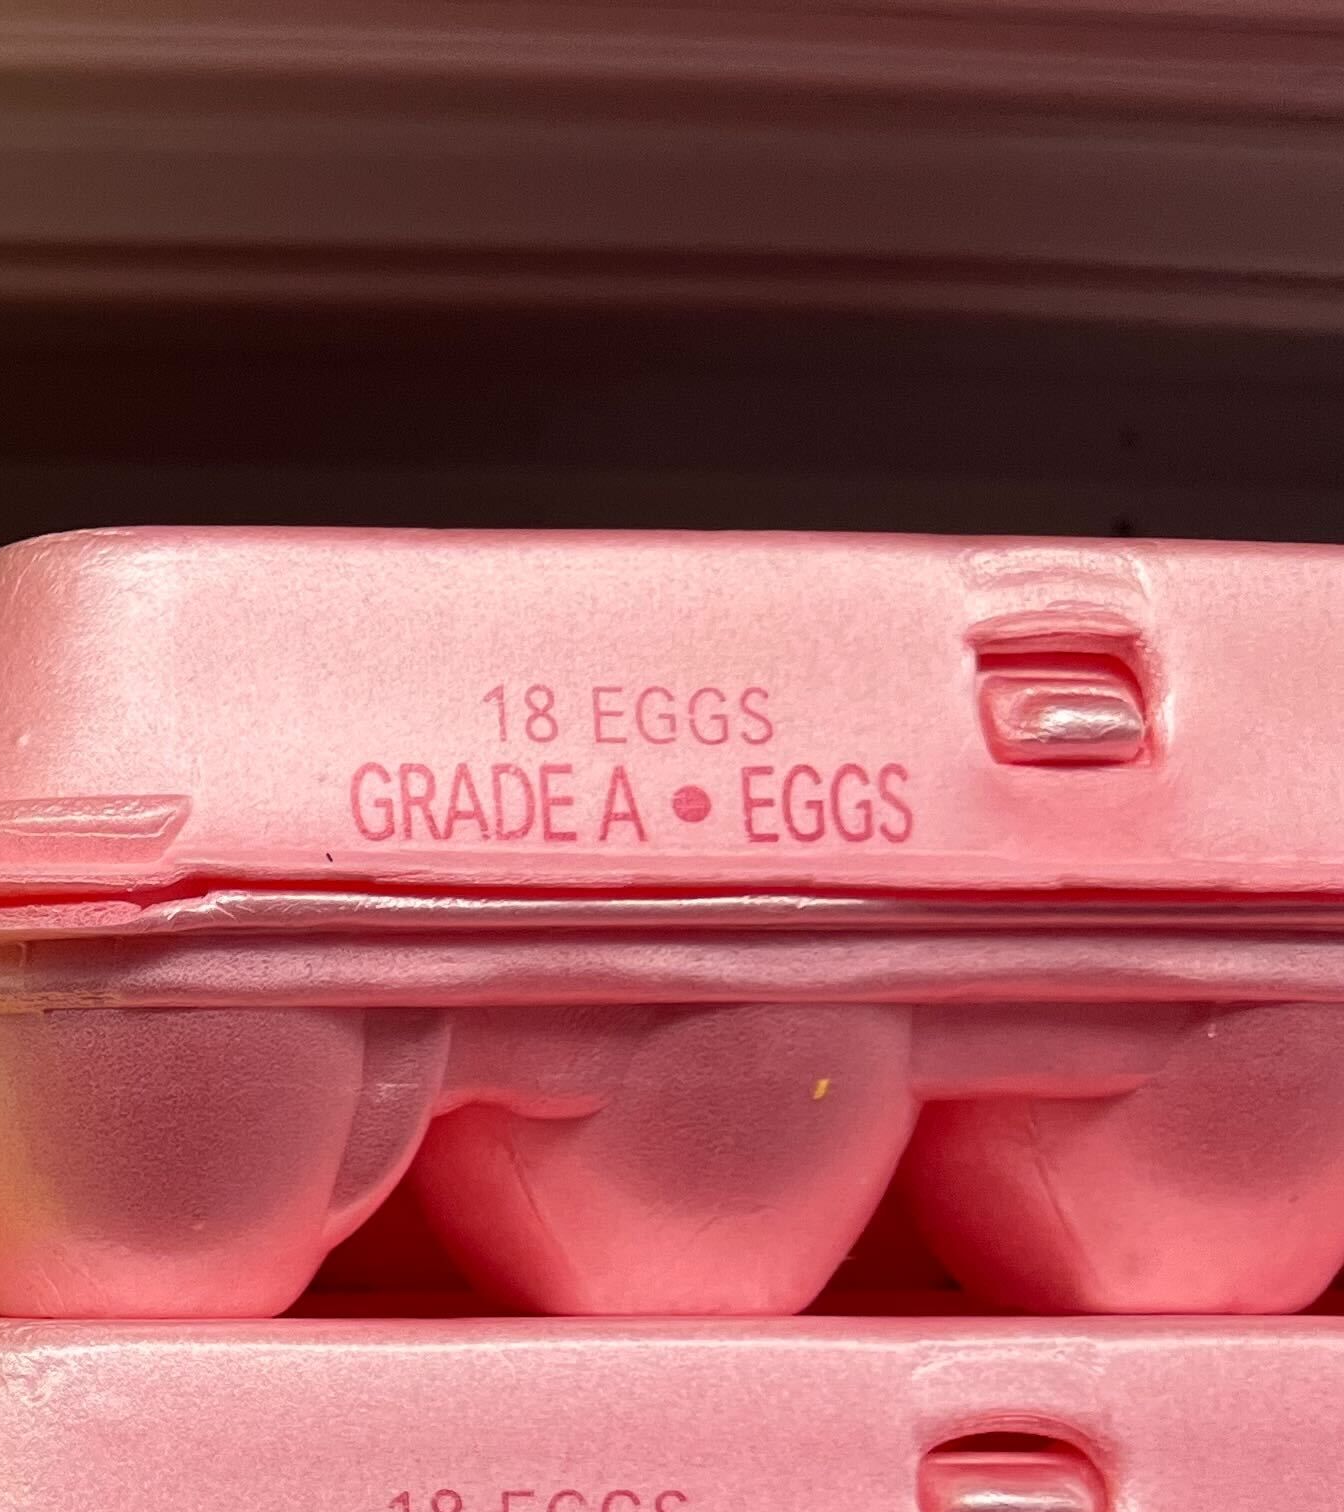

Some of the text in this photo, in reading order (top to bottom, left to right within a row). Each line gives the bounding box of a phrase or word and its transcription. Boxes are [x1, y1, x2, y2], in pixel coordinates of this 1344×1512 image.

[483, 685, 774, 745] 18 EGGS
[351, 762, 911, 843] GRADE A EGGS
